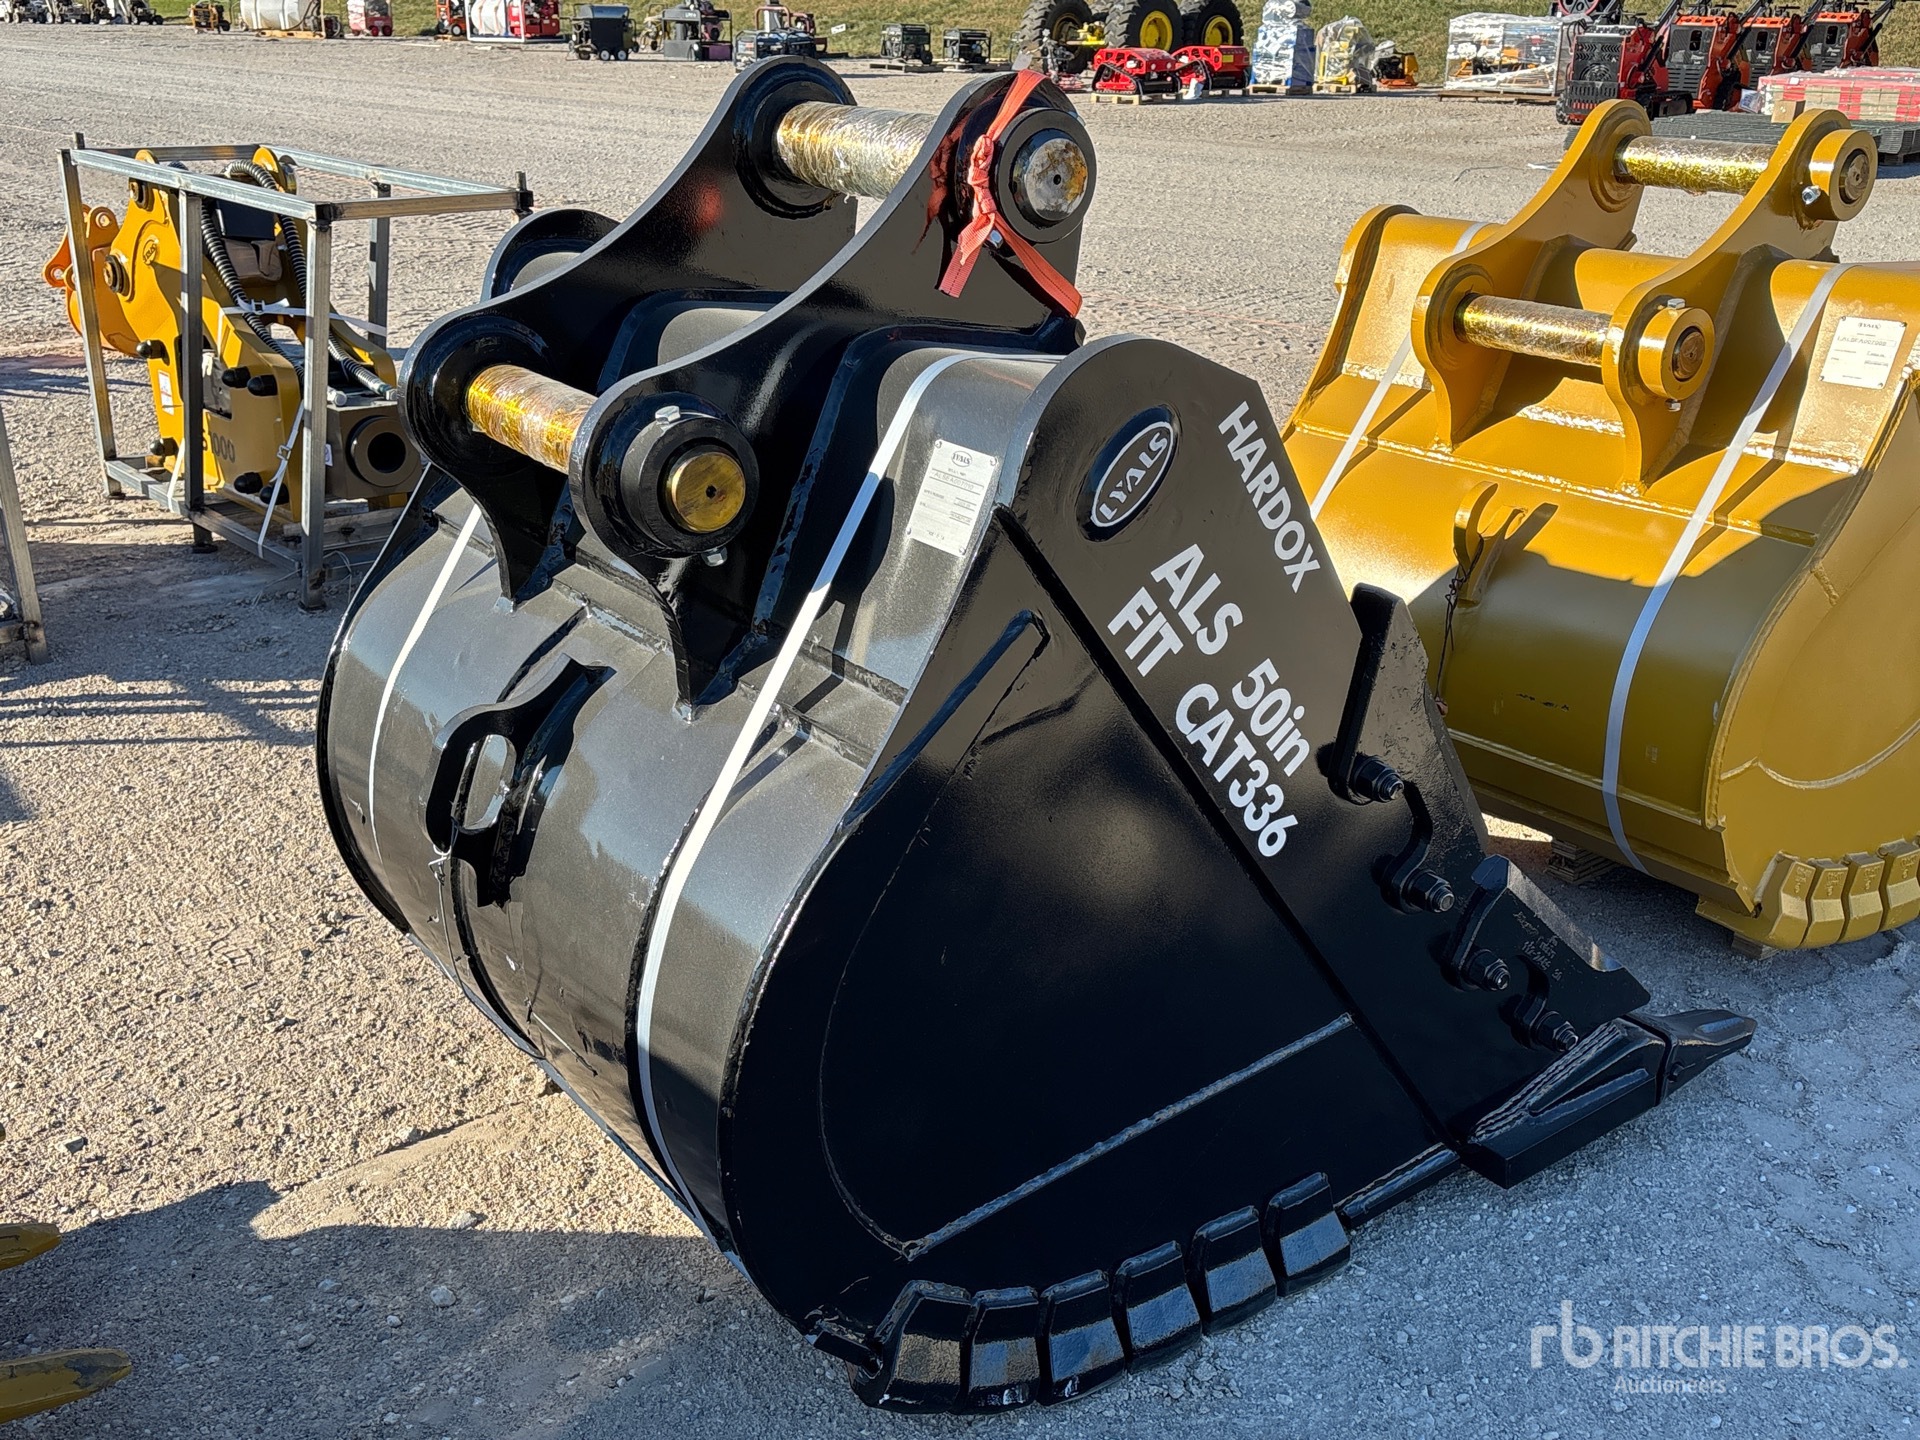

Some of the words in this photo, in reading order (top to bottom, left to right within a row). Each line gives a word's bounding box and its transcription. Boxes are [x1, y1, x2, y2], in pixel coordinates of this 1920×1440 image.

[1099, 432, 1168, 521] LYALS
[1218, 401, 1320, 593] HARDOX
[1106, 586, 1184, 678] FIT
[1175, 683, 1299, 857] CAT336
[1150, 543, 1244, 656] ALS
[1231, 657, 1311, 778] 50in
